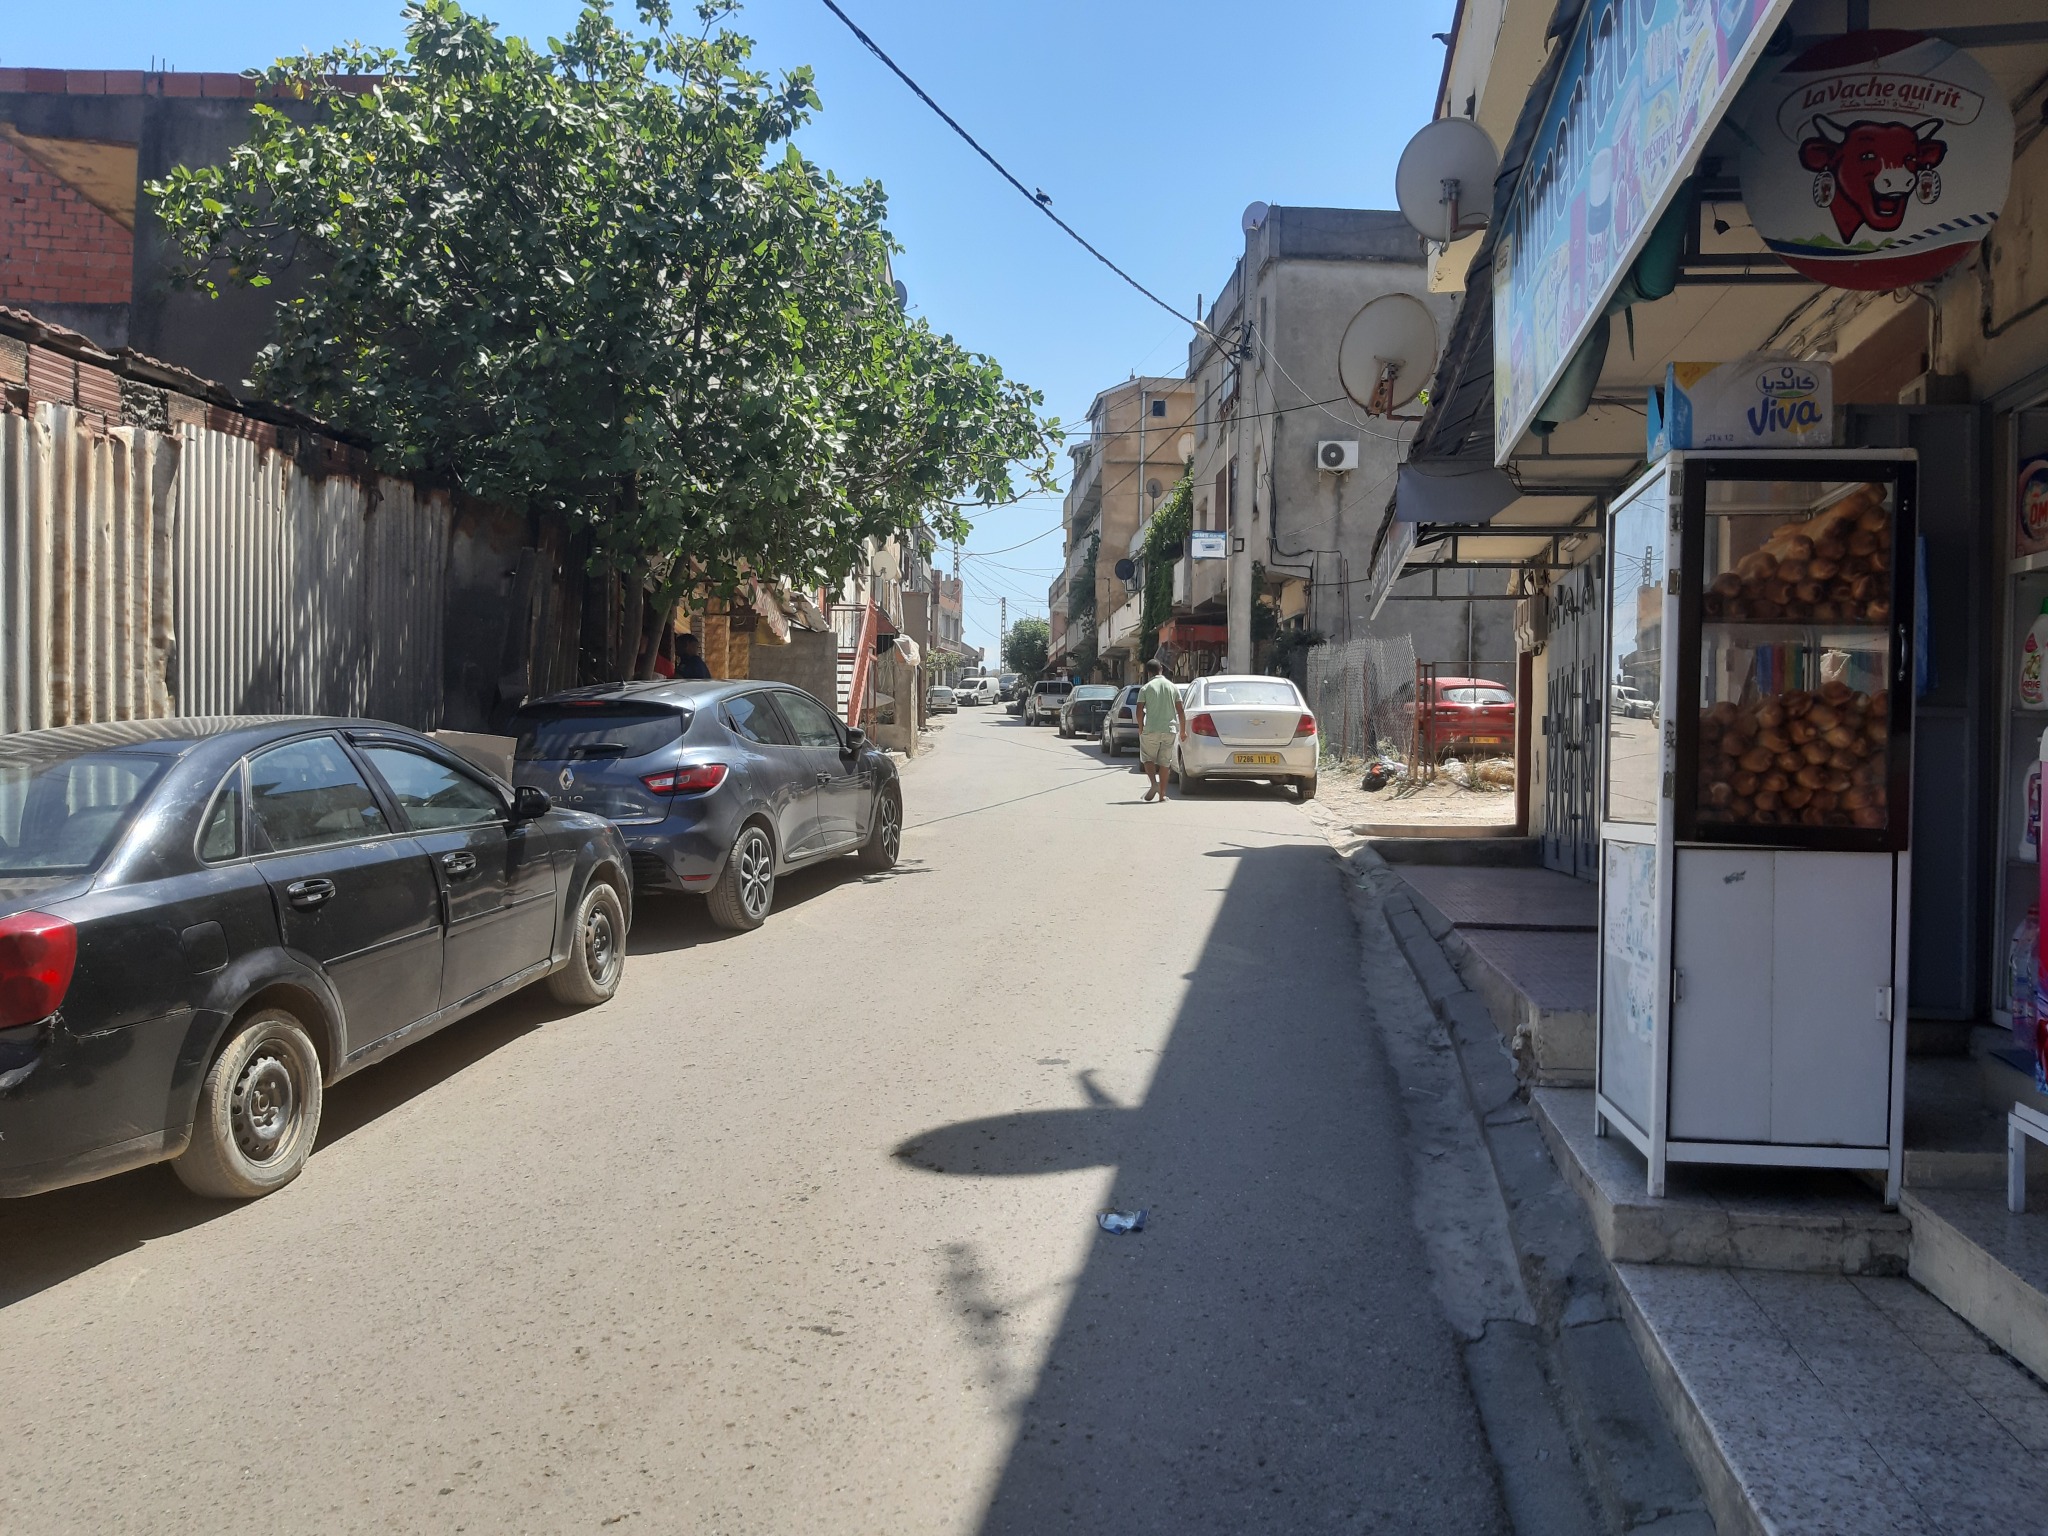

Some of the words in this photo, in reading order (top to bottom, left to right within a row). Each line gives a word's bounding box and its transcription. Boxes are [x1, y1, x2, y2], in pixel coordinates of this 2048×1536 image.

[1803, 89, 1826, 109] La
[1827, 76, 1894, 101] Vache
[1897, 83, 1934, 102] qui
[1932, 87, 1961, 109] rit
[1513, 0, 1656, 321] Alimentat
[1762, 367, 1815, 393] كانديا
[1747, 397, 1822, 436] Viva
[550, 795, 584, 803] CLIO
